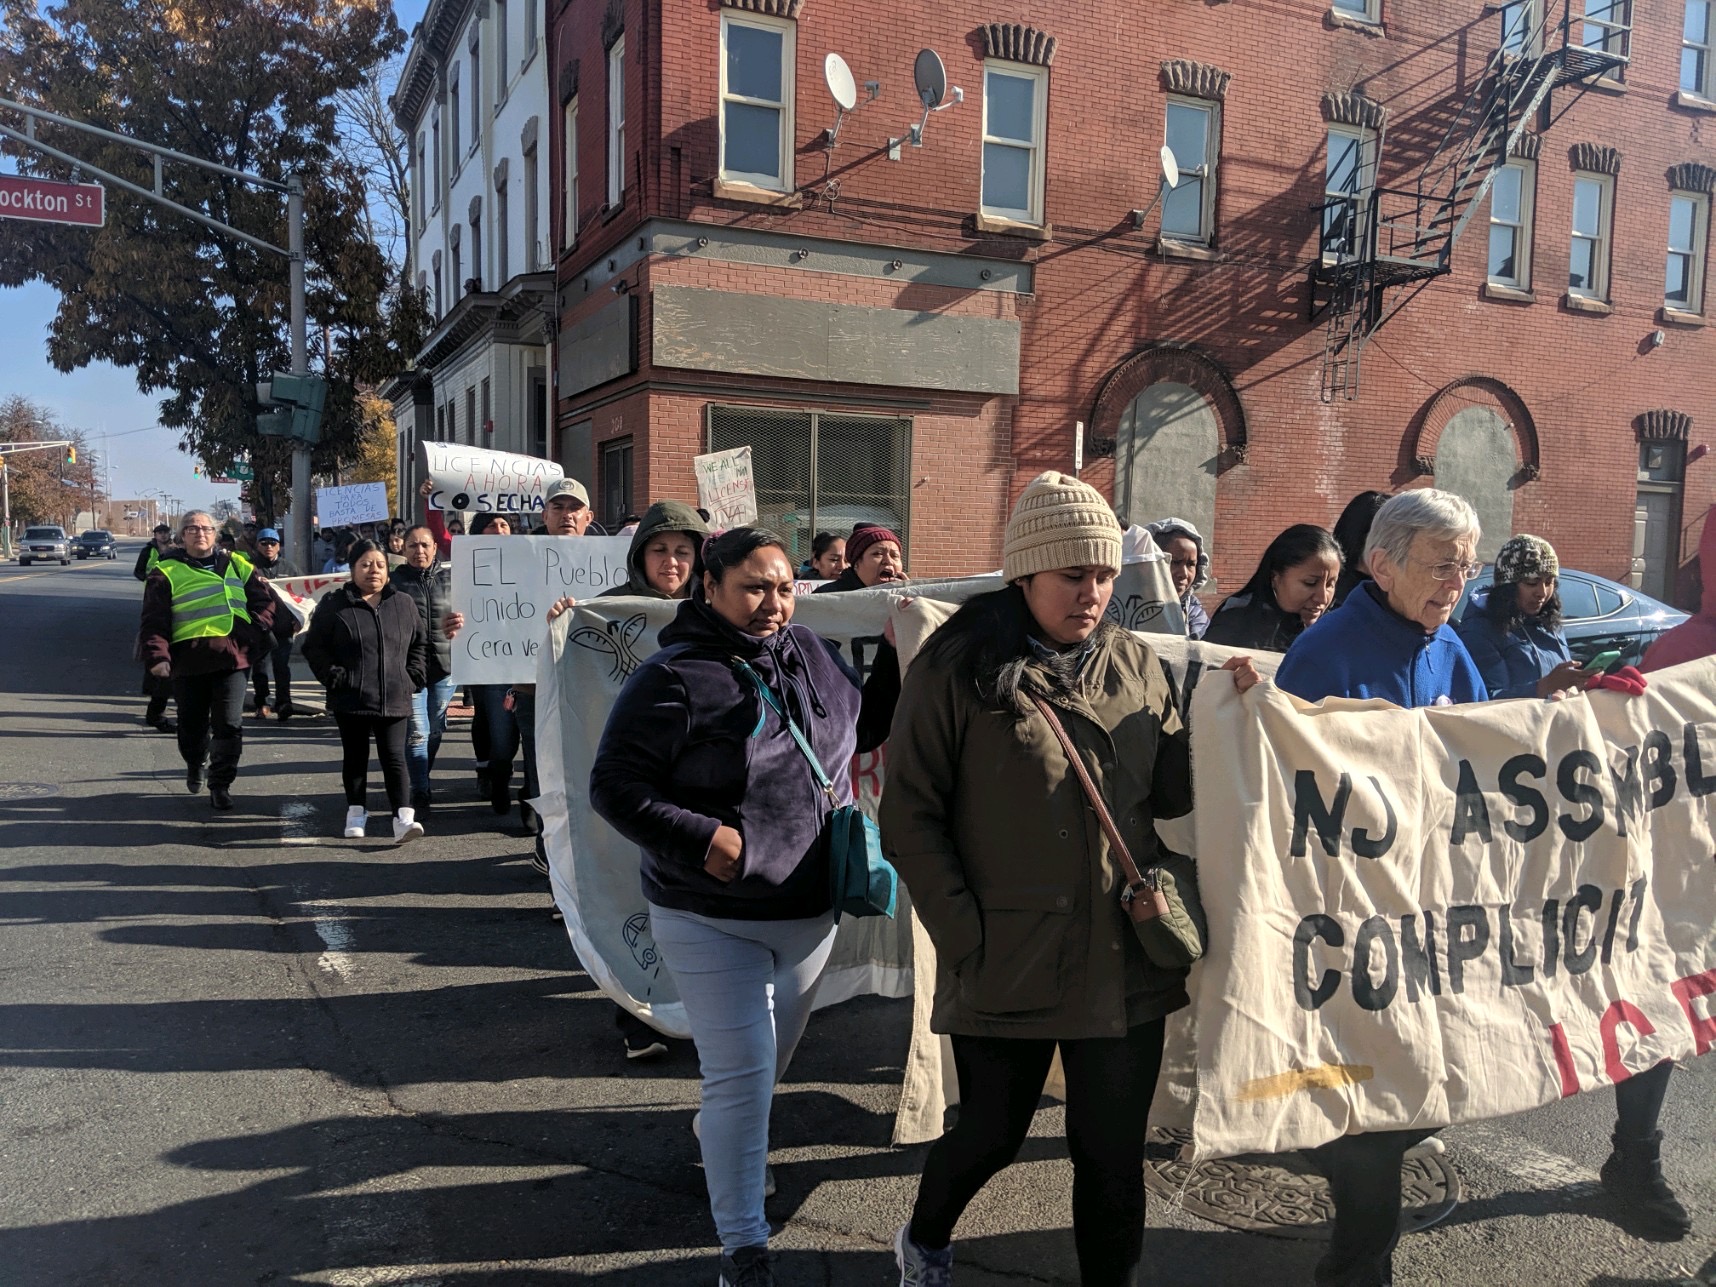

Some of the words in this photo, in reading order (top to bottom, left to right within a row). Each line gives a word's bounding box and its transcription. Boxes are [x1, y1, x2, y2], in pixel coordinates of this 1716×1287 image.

[75, 193, 92, 208] St
[433, 455, 562, 476] LICENCIAS
[703, 461, 719, 474] WE
[720, 456, 740, 472] ALL
[317, 484, 380, 498] LICENCIAS
[464, 473, 543, 494] AHORA
[335, 498, 370, 510] TODOS
[340, 493, 363, 501] PARA
[430, 490, 546, 513] COSECHA
[329, 508, 357, 518] BASTA
[365, 504, 377, 513] DE
[331, 511, 382, 525] PROMESAS
[472, 547, 517, 587] EL
[545, 547, 629, 587] Pueblo
[467, 631, 513, 661] Cera
[1290, 769, 1398, 859] NJ
